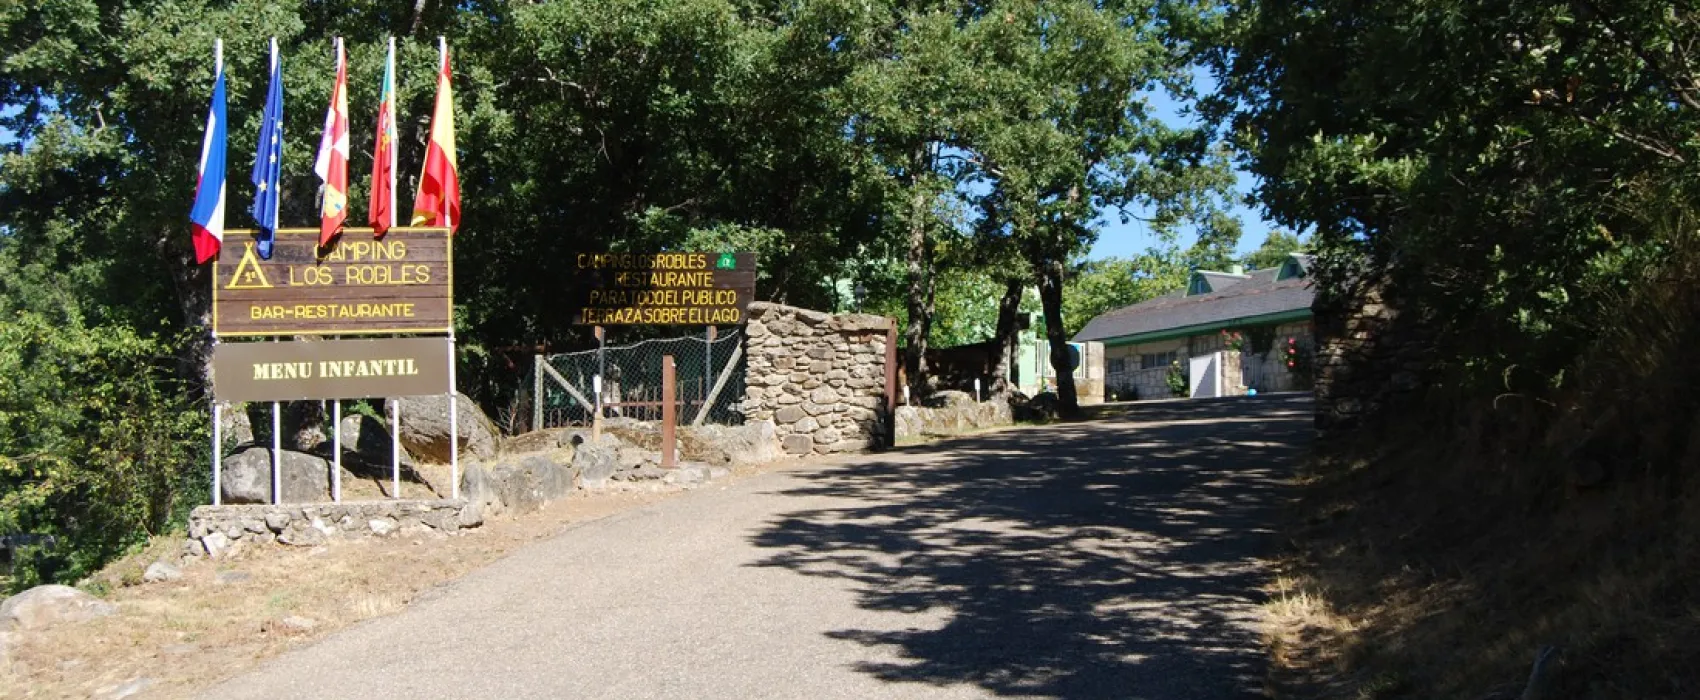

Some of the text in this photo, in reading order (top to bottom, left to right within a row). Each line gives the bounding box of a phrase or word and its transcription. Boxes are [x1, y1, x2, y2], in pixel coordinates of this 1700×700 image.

[577, 253, 632, 269] CAMPING
[656, 253, 707, 269] ROBLES
[289, 264, 431, 287] LOS ROBLES
[615, 271, 714, 288] RESTAURANTE
[589, 289, 628, 305] PARA
[665, 289, 680, 305] EL
[682, 289, 737, 306] PUBLICO
[251, 303, 415, 319] BAR-RESTAURANTE
[581, 307, 740, 325] TERRAZA SOBRE EL LAGO
[253, 358, 418, 381] MENU INFANTIL
